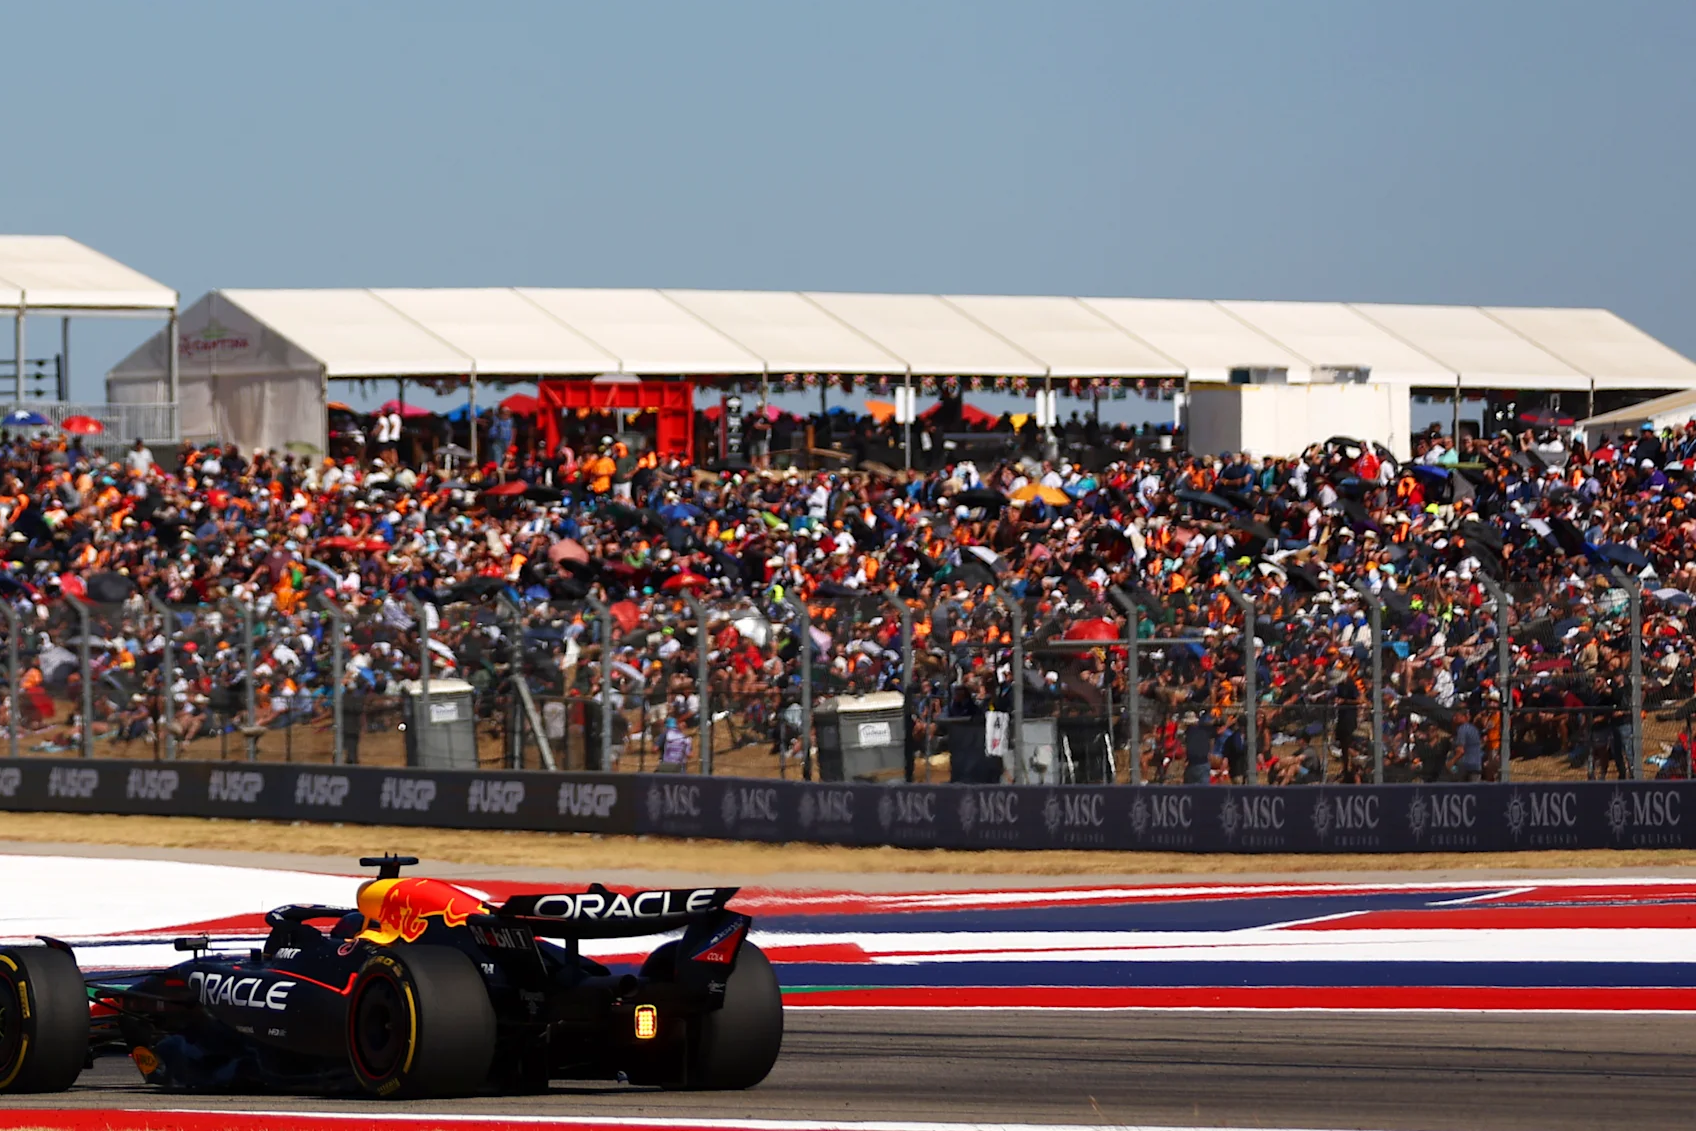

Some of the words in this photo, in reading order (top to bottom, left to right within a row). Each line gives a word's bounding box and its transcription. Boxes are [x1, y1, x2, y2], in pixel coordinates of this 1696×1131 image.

[208, 770, 265, 803] #USGP
[295, 773, 350, 806] #USGP
[380, 777, 437, 811] #USGP
[467, 780, 525, 814] #USGP
[557, 782, 618, 817] #USGP
[663, 784, 701, 816] MSC
[740, 788, 779, 821] MSC
[817, 790, 853, 822] MSC
[896, 791, 936, 823] MSC
[979, 791, 1019, 824] MSC
[1064, 793, 1104, 827] MSC
[1151, 794, 1193, 828] MSC
[1241, 795, 1285, 829] MSC
[1334, 794, 1380, 829] MSC
[1430, 793, 1477, 828] MSC
[1529, 792, 1578, 827] MSC
[1631, 790, 1681, 826] MSC
[534, 888, 716, 920] ORACLE
[188, 971, 297, 1011] ORACLE
